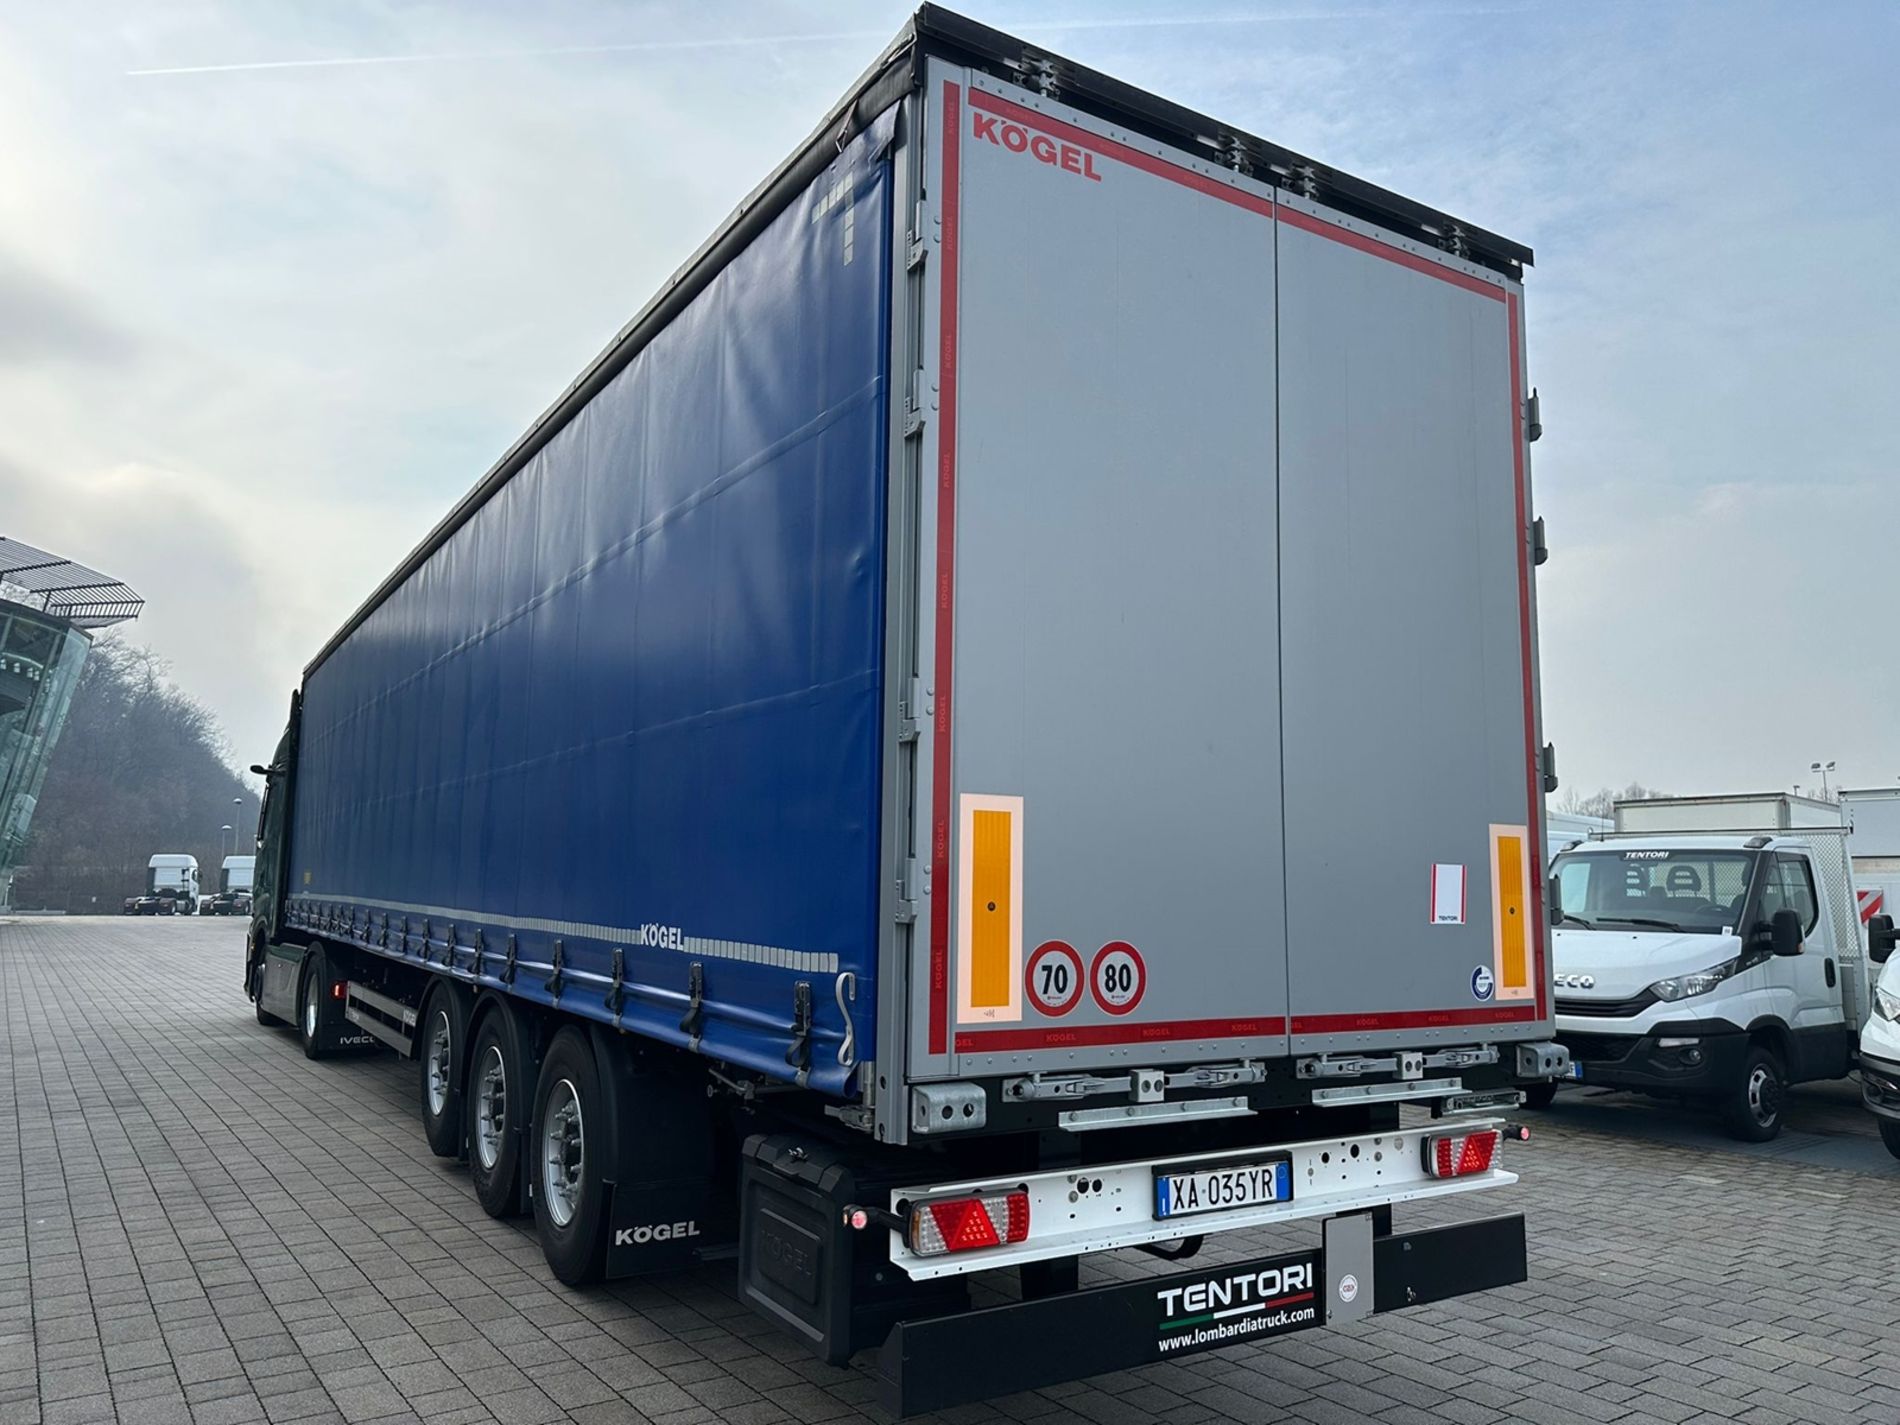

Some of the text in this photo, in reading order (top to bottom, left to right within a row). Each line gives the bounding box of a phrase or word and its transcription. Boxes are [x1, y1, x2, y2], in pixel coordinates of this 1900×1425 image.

[973, 112, 1101, 182] KÖGEL
[1625, 851, 1669, 859] TENTORI
[641, 923, 683, 950] KÖGEL
[1041, 964, 1068, 994] 70
[1104, 964, 1132, 993] 80
[1173, 1168, 1273, 1210] XA 035YR
[615, 1221, 700, 1246] KÖGEL
[1157, 1263, 1313, 1317] TENTORI
[1158, 1307, 1315, 1352] www.lombardiatruck.com
